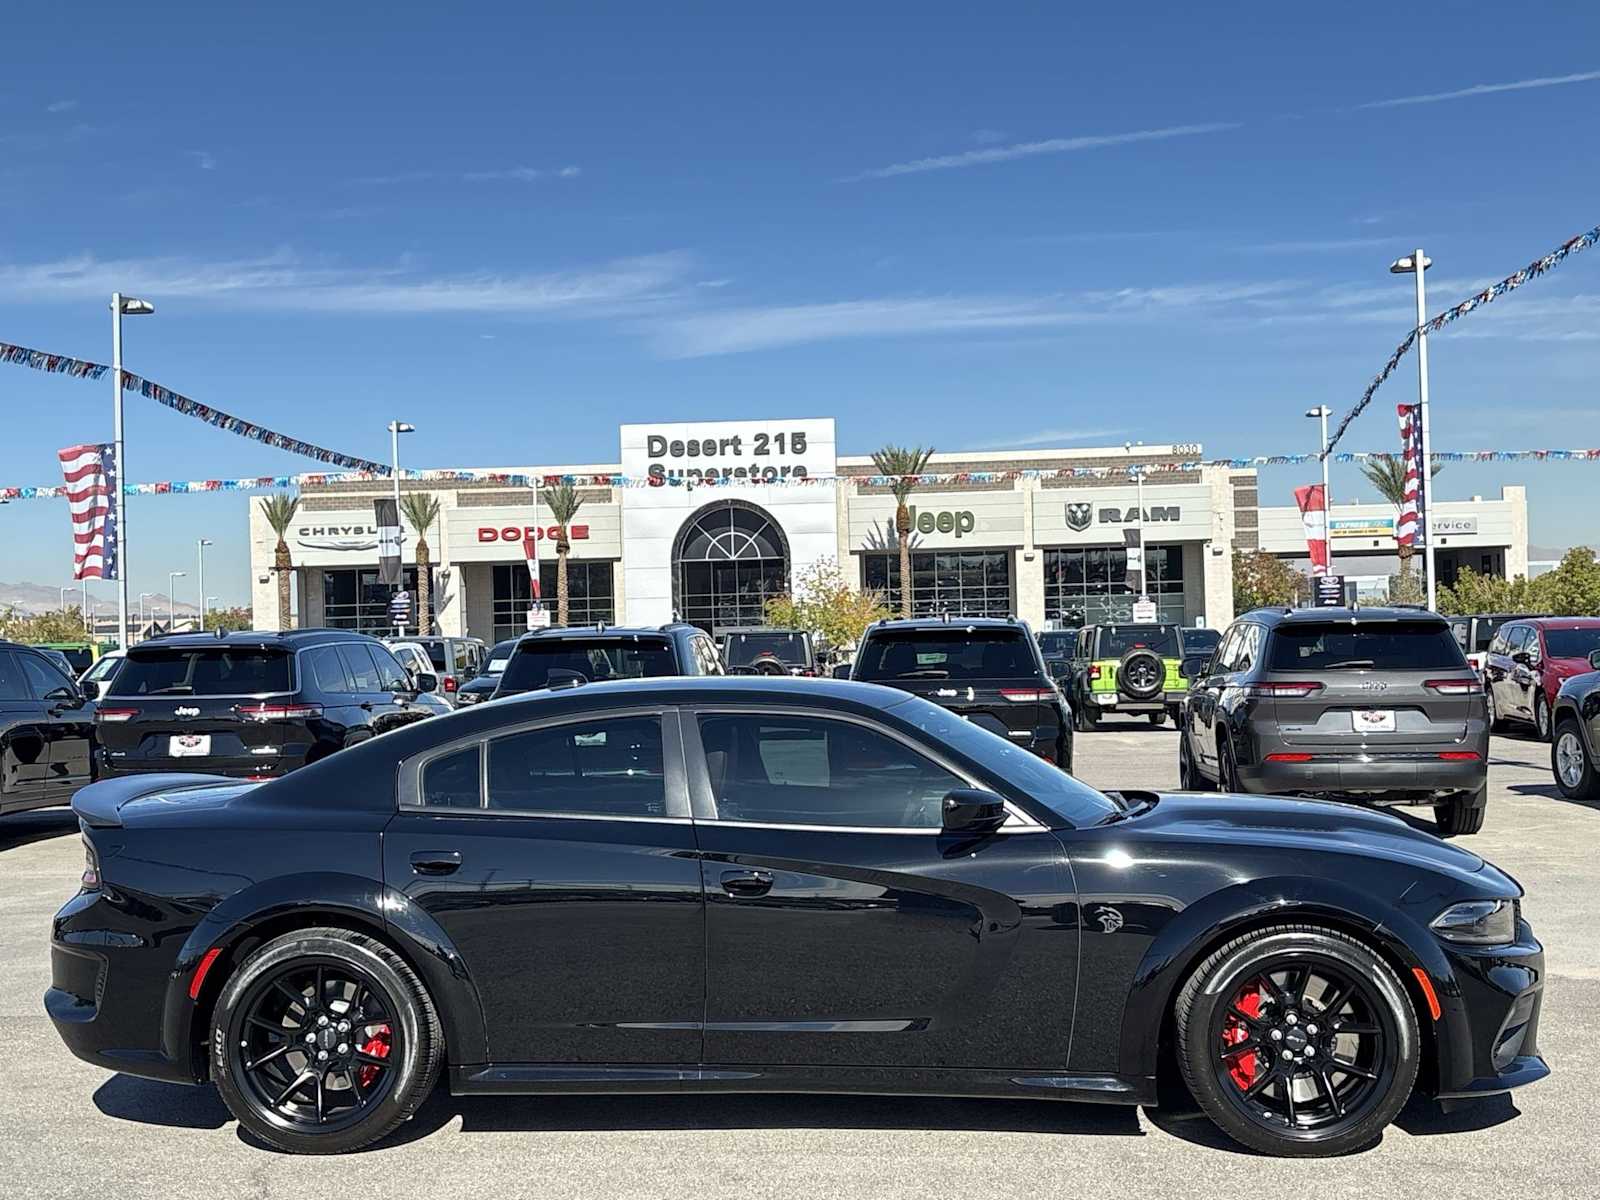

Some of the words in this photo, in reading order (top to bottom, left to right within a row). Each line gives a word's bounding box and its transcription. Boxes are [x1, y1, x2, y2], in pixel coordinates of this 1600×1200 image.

[646, 434, 743, 458] Desert
[753, 431, 807, 455] 215
[1171, 443, 1199, 456] 8030
[647, 463, 808, 491] Superstore
[907, 505, 975, 538] Jeep
[1099, 506, 1181, 523] RAM
[1432, 520, 1472, 530] ervice
[478, 525, 590, 543] DODGE
[174, 706, 201, 717] Jeep
